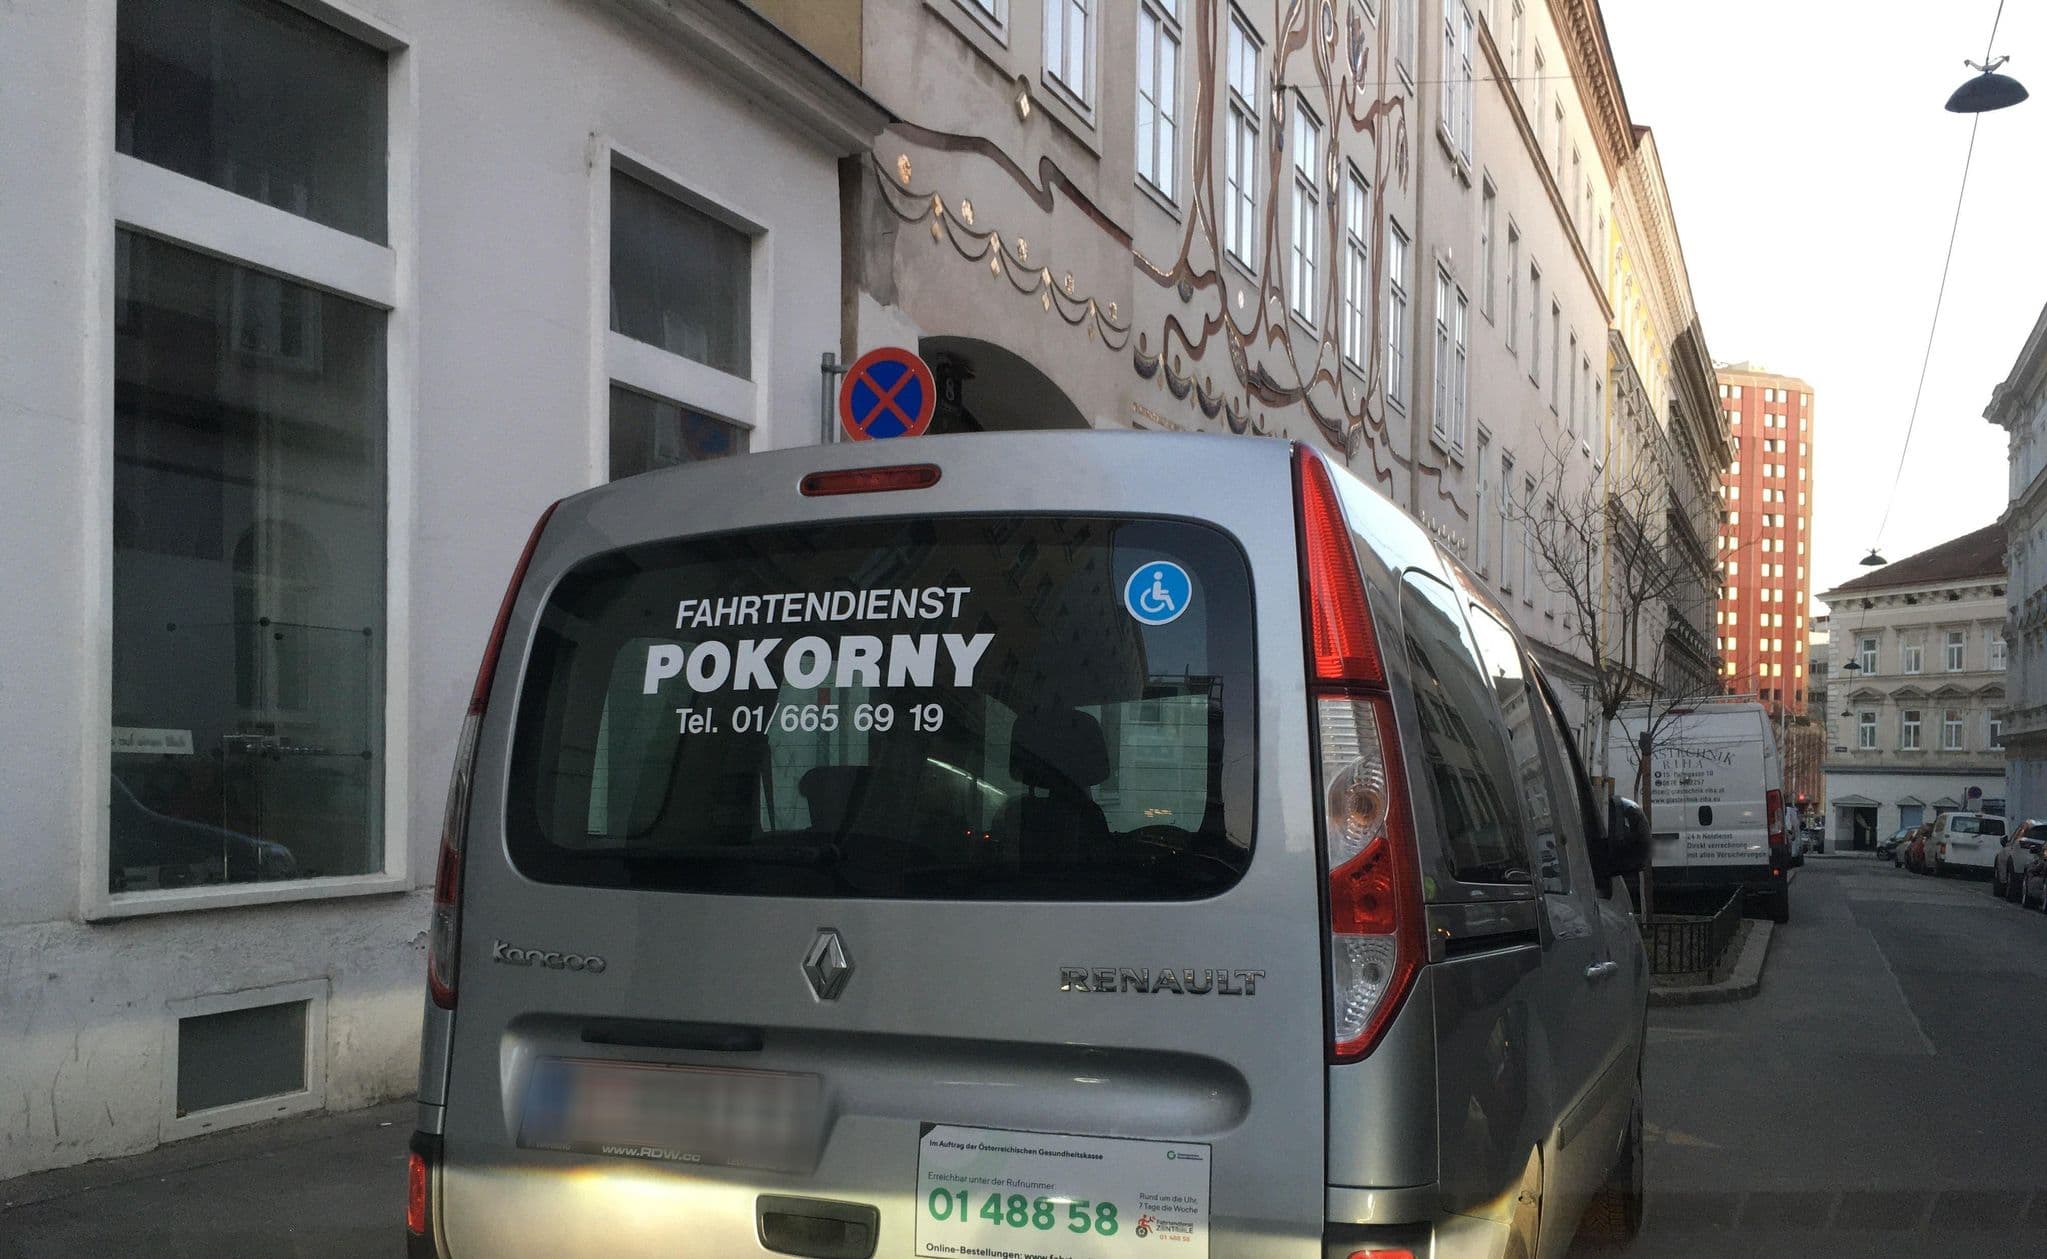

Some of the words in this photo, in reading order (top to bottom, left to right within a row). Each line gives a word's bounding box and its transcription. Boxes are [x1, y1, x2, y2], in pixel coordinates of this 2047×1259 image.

[675, 587, 970, 629] FAHRTENDIENST
[643, 633, 995, 695] POKORNY
[676, 707, 719, 734] Tel.
[732, 703, 839, 735] 01/665
[854, 703, 894, 732] 69
[909, 703, 943, 732] 19
[1059, 966, 1266, 996] RENAULT
[929, 1139, 938, 1147] Im
[939, 1140, 964, 1150] Auftrag
[966, 1142, 977, 1150] der
[978, 1142, 1037, 1155] Österreichischen
[1038, 1148, 1104, 1161] Gesundheitskasse
[928, 1171, 967, 1183] Erreichbar
[968, 1175, 990, 1185] unter
[991, 1176, 1005, 1186] der
[1139, 1192, 1158, 1201] Rund
[1171, 1195, 1182, 1203] die
[1144, 1202, 1160, 1212] Tage
[1161, 1204, 1172, 1212] die
[1173, 1204, 1199, 1214] Woche
[928, 1187, 968, 1222] 01
[979, 1192, 1055, 1231] 488
[1067, 1199, 1119, 1236] 58
[1156, 1225, 1193, 1233] ZNTLE
[926, 1242, 1023, 1259] Online-Bestellungen:
